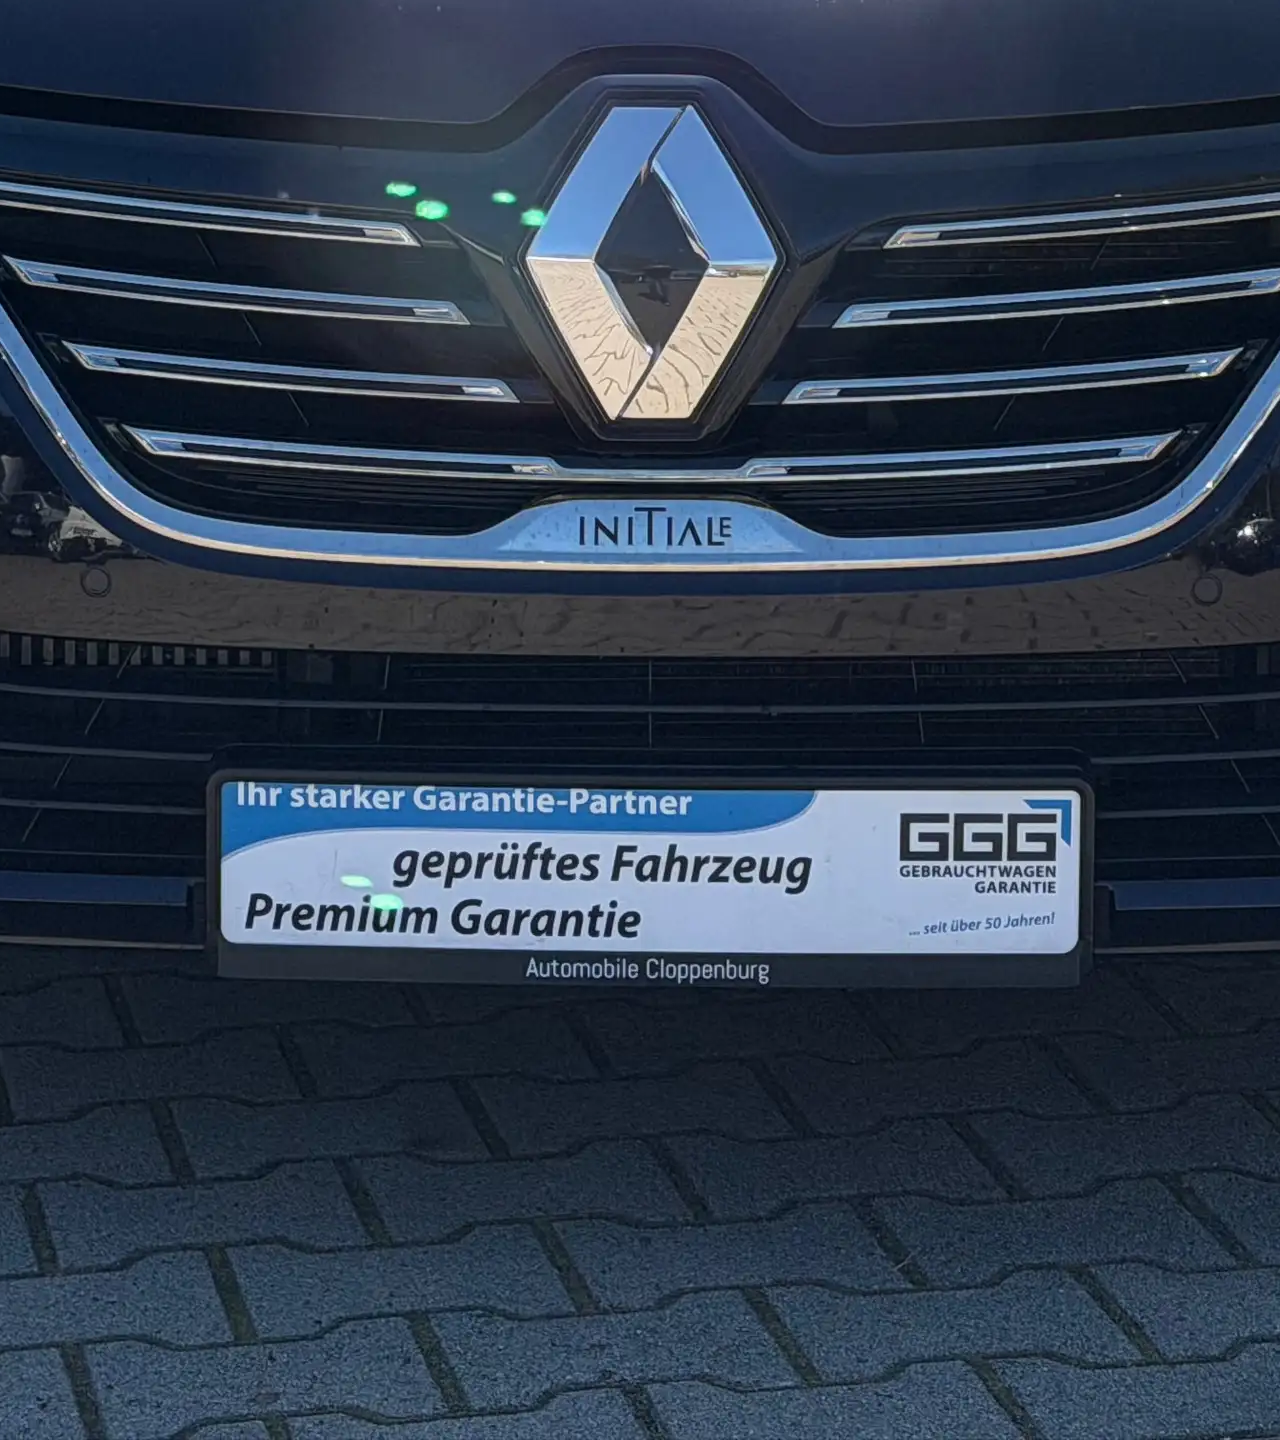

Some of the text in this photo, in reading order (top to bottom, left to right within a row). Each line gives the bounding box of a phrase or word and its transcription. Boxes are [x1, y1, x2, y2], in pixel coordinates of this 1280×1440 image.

[579, 507, 732, 547] INITIALE
[236, 781, 692, 816] Ihr starker Garantie-Partner
[899, 812, 1058, 862] GGG
[392, 841, 813, 895] geprüftes Fahrzeug
[899, 864, 1058, 879] GEBRAUCHTWAGEN
[974, 880, 1058, 895] GARANTIE
[244, 892, 641, 939] Premium Garantie
[923, 921, 948, 935] seit
[950, 918, 983, 933] über
[984, 917, 1002, 931] 50
[1004, 912, 1055, 928] Jahren!
[525, 957, 770, 984] Automobile Cloppenburg
